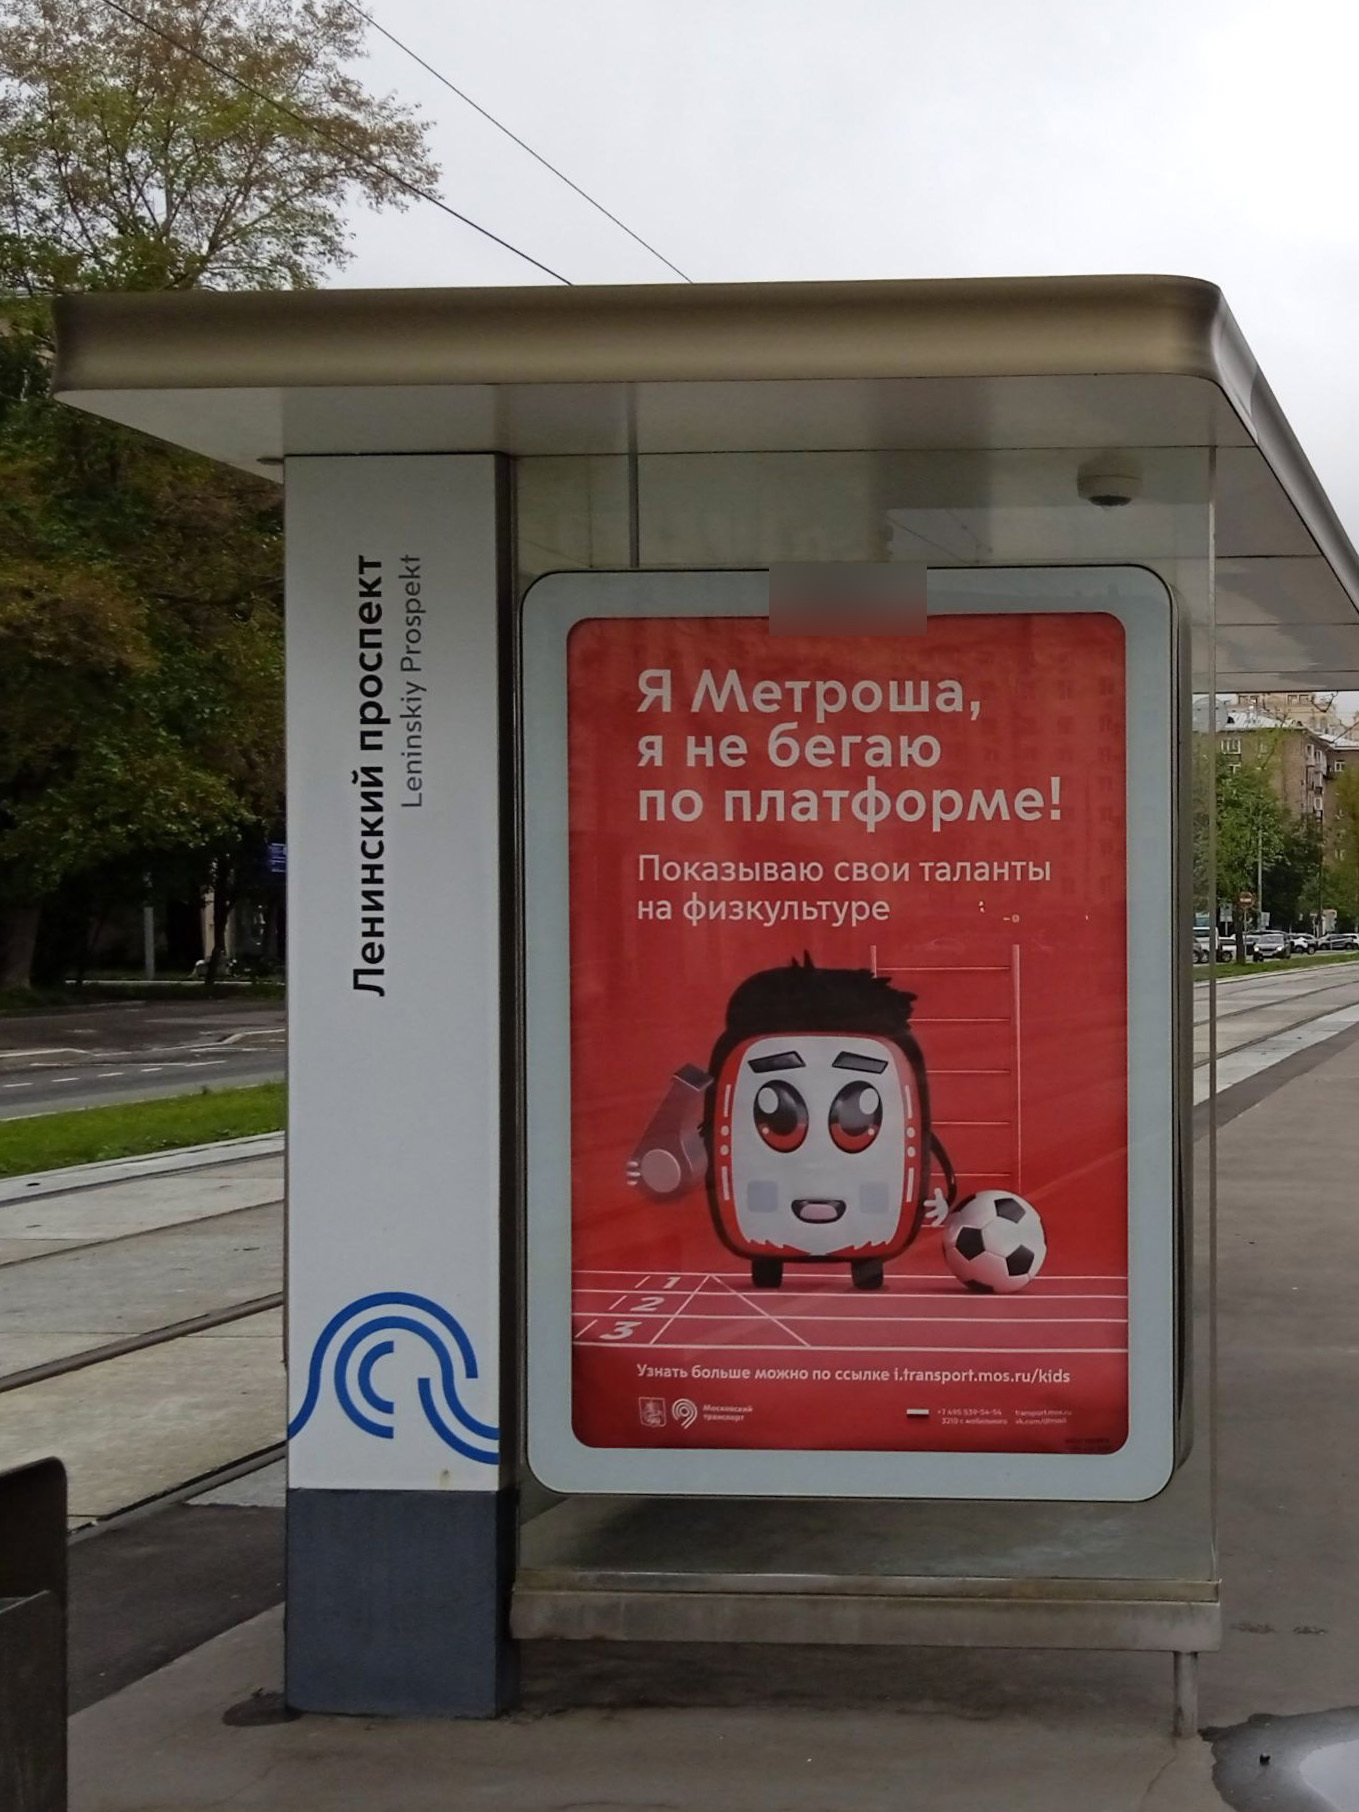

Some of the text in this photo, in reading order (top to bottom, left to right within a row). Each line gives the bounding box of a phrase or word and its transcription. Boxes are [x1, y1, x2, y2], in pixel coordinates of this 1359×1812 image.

[398, 554, 428, 808] Leninskiy Prospekt
[638, 669, 981, 723] Я Метроша,
[637, 722, 941, 767] я не бегаю
[352, 555, 391, 997] Ленинский проспект
[639, 776, 1061, 832] по платформе!
[639, 855, 1051, 882] Показываю свои таланты
[638, 892, 891, 926] на физкультуре
[663, 1276, 681, 1289] 1
[630, 1296, 665, 1312] 2
[600, 1320, 643, 1340] 3
[636, 1363, 1071, 1385] Узнать больше можно по ссылке i.transport.mos.ru/kids
